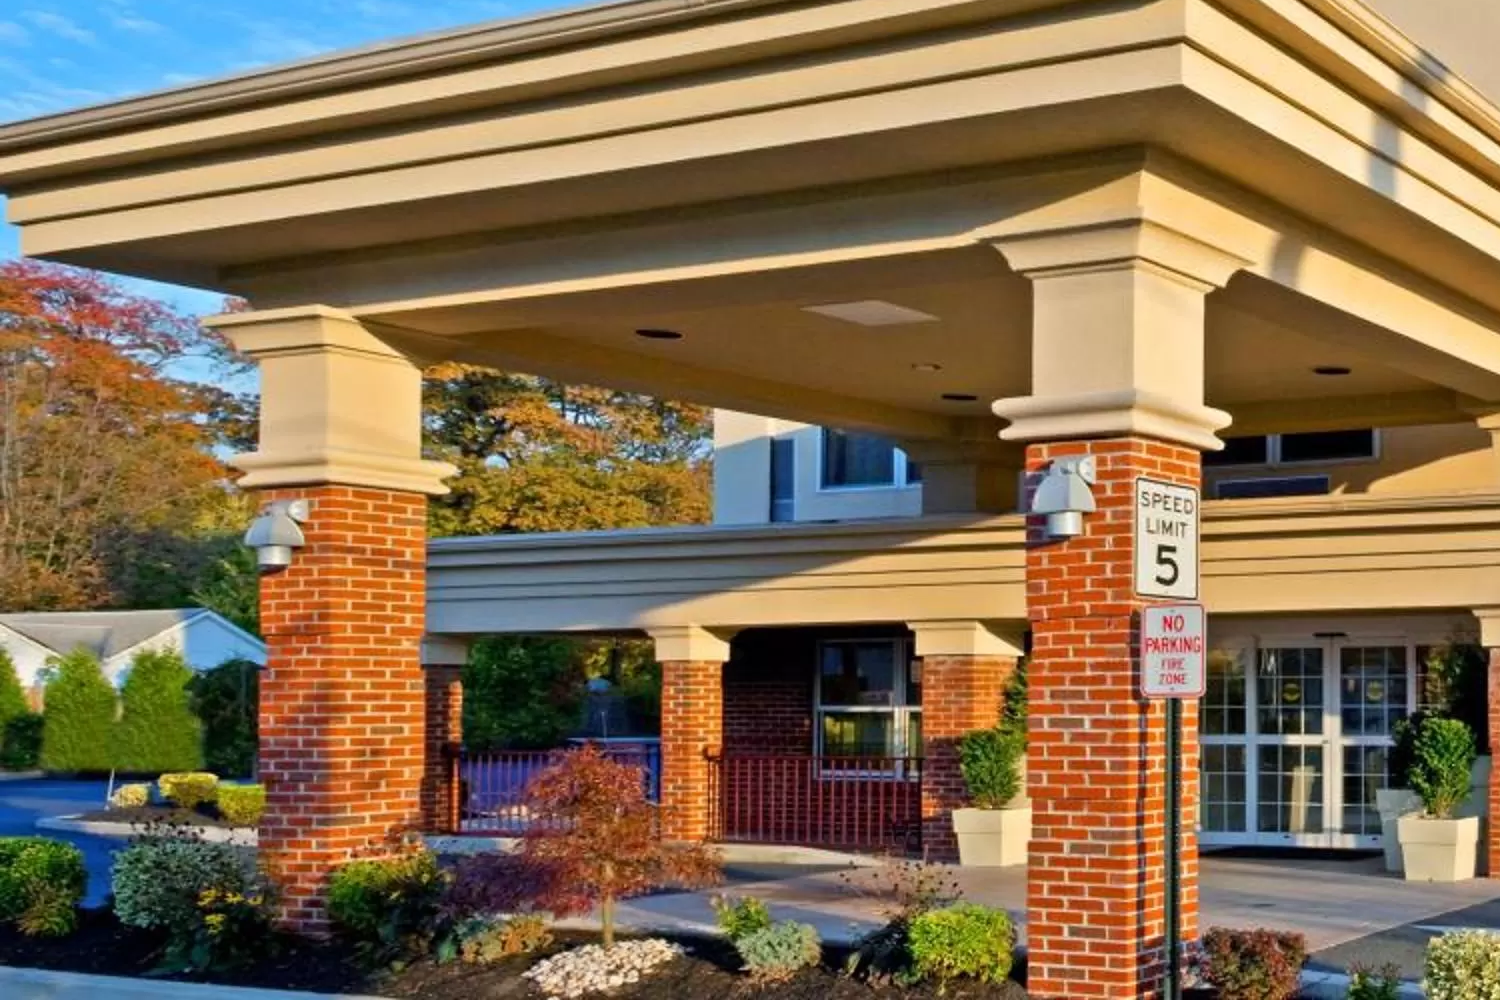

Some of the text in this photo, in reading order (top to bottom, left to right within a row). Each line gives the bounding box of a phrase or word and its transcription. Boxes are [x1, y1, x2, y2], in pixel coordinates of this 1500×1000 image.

[1140, 491, 1194, 516] SPEED
[1145, 517, 1188, 539] LIMIT
[1155, 544, 1179, 587] 5
[1162, 614, 1185, 633] NO
[1145, 637, 1201, 655] PARKING
[1161, 658, 1185, 671] FIRE
[1158, 673, 1188, 686] ZONE
